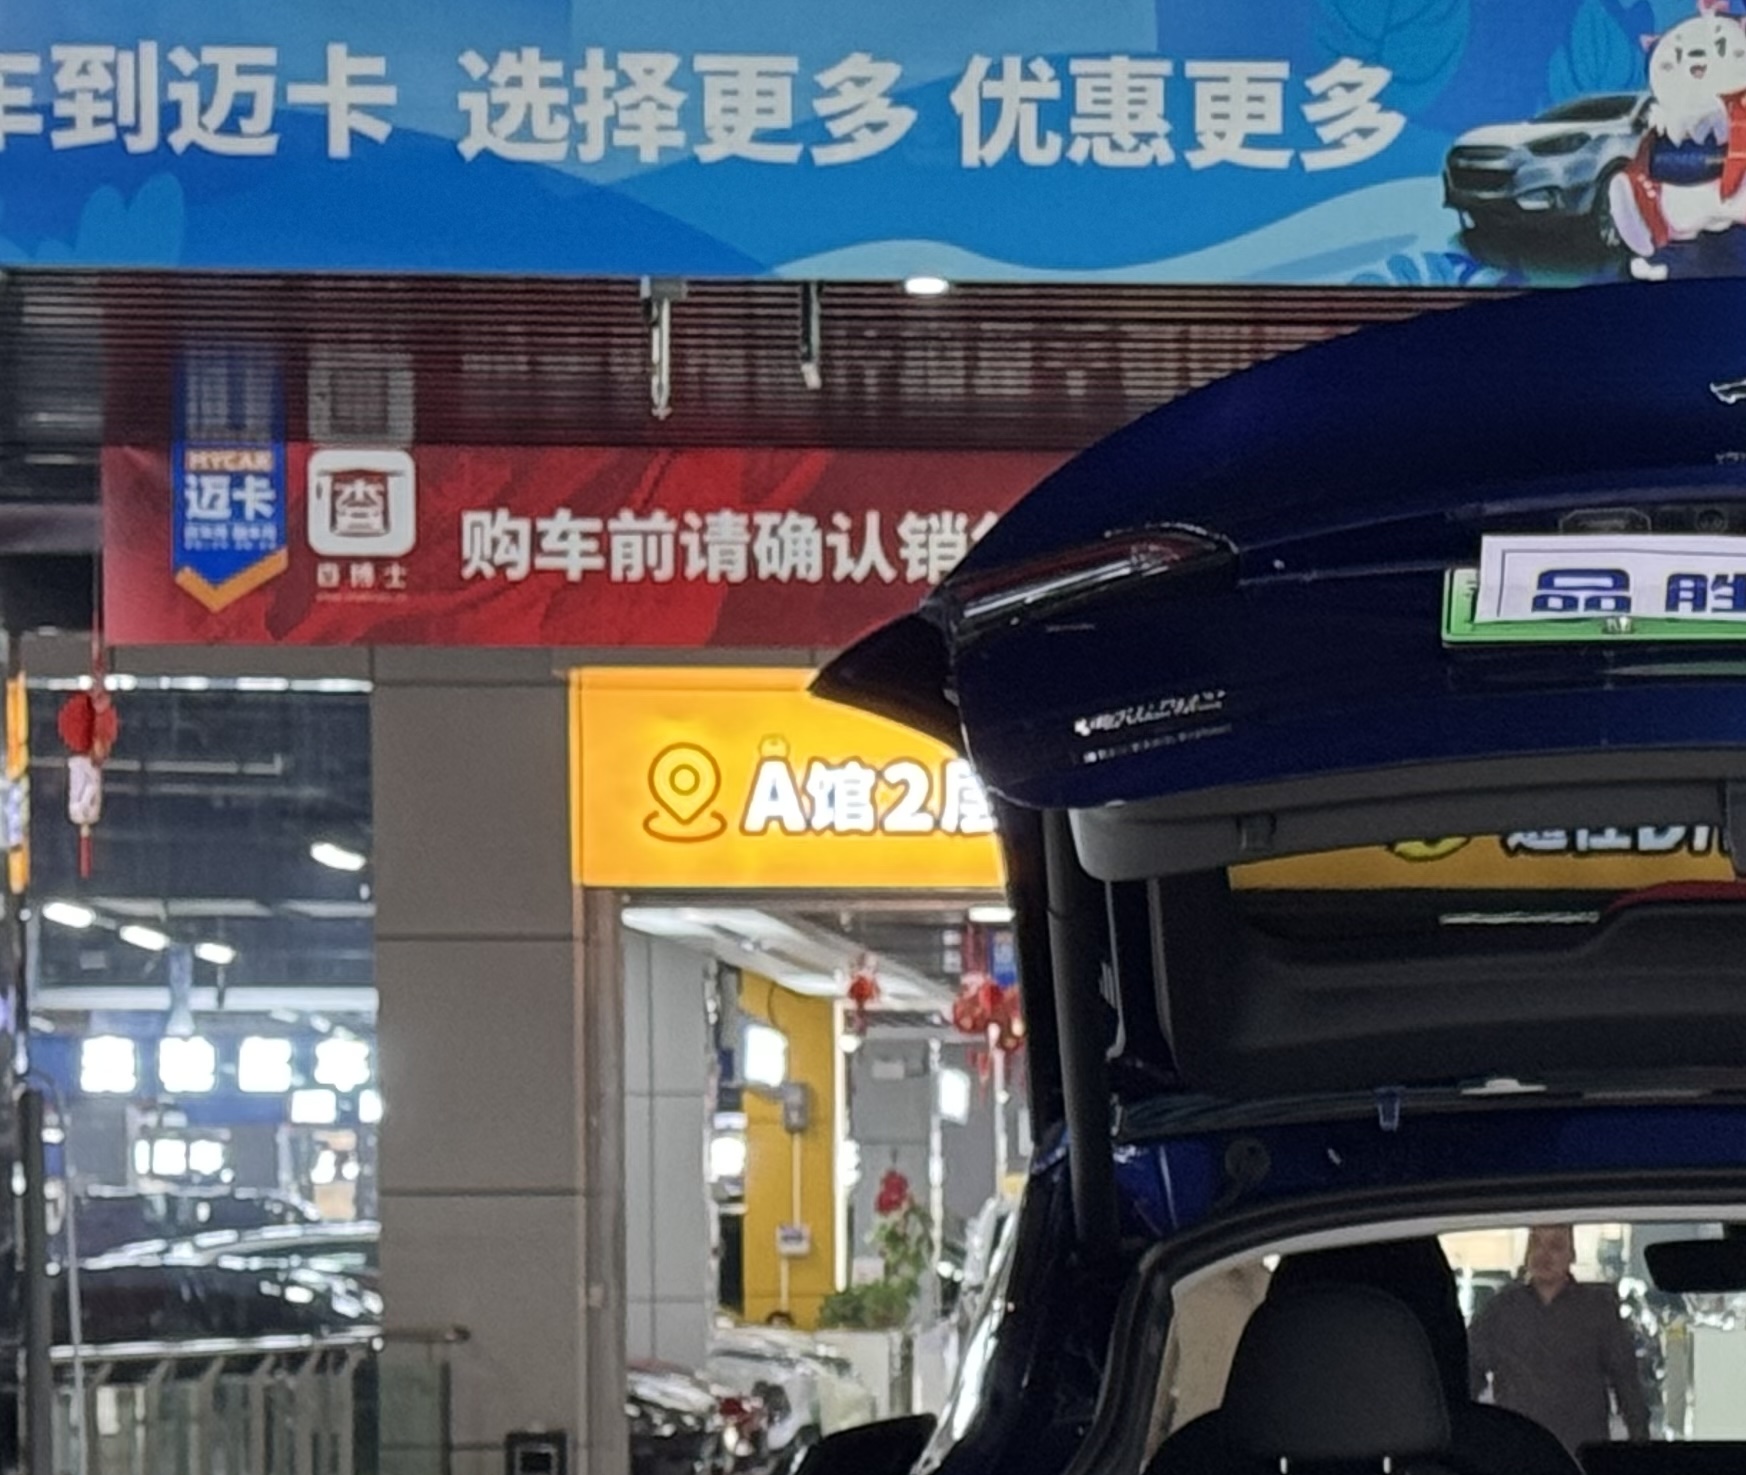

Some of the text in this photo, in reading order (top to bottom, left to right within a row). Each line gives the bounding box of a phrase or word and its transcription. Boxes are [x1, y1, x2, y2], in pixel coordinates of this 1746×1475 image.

[457, 47, 918, 167] 选择更多
[949, 53, 1407, 173] 优惠更多
[184, 473, 277, 521] 迈卡
[461, 508, 1000, 585] 购车前请确认销
